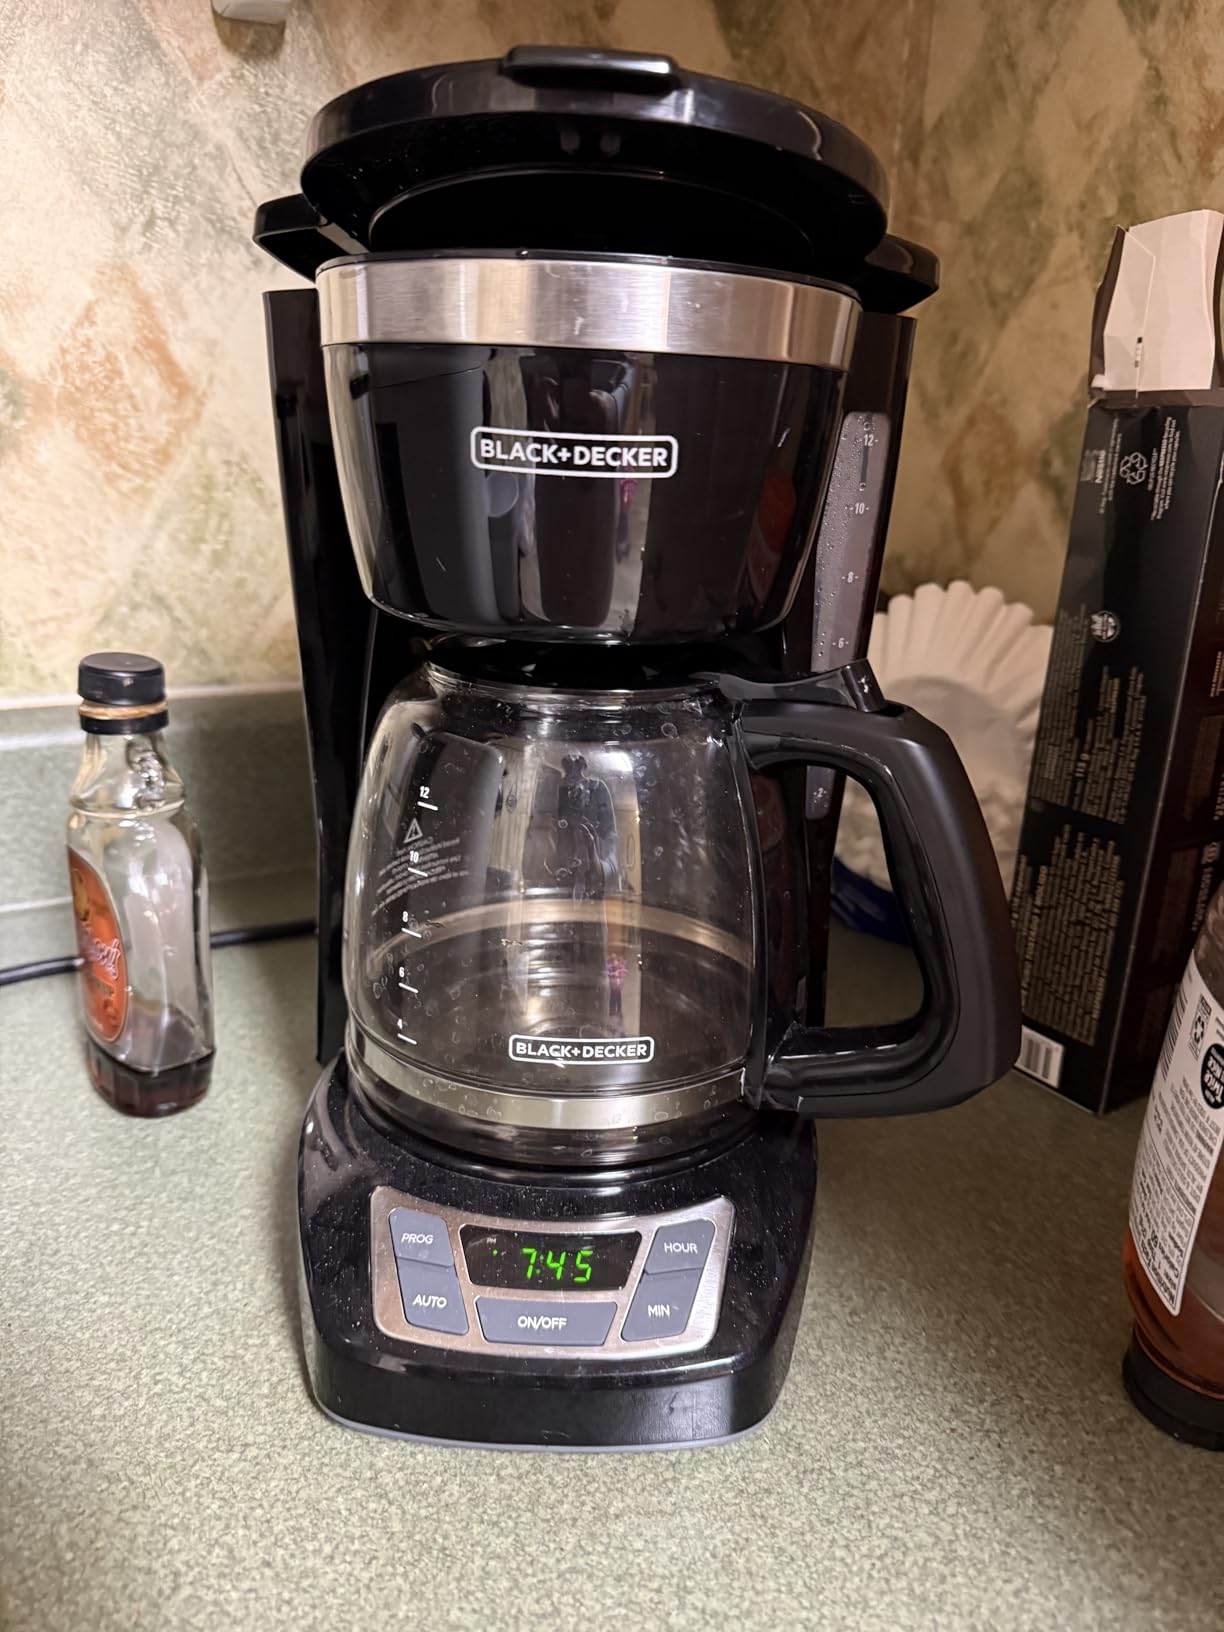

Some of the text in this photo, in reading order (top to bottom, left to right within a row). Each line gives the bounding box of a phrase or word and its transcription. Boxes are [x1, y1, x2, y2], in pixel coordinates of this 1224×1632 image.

[863, 434, 874, 447] 12
[480, 439, 668, 467] BLACK+DECKER
[855, 503, 865, 515] 10
[419, 786, 430, 799] 12
[409, 850, 419, 863] 10
[402, 911, 409, 923] 8
[399, 967, 404, 978] 6
[397, 1018, 403, 1030] 4
[516, 1042, 648, 1057] BLACK+DECKER
[401, 1233, 434, 1244] PROG
[663, 1242, 698, 1253] HOUR
[521, 1247, 593, 1283] 7:45
[412, 1294, 447, 1309] AUTO
[648, 1304, 670, 1318] MIN
[517, 1315, 568, 1330] ON/OFF
